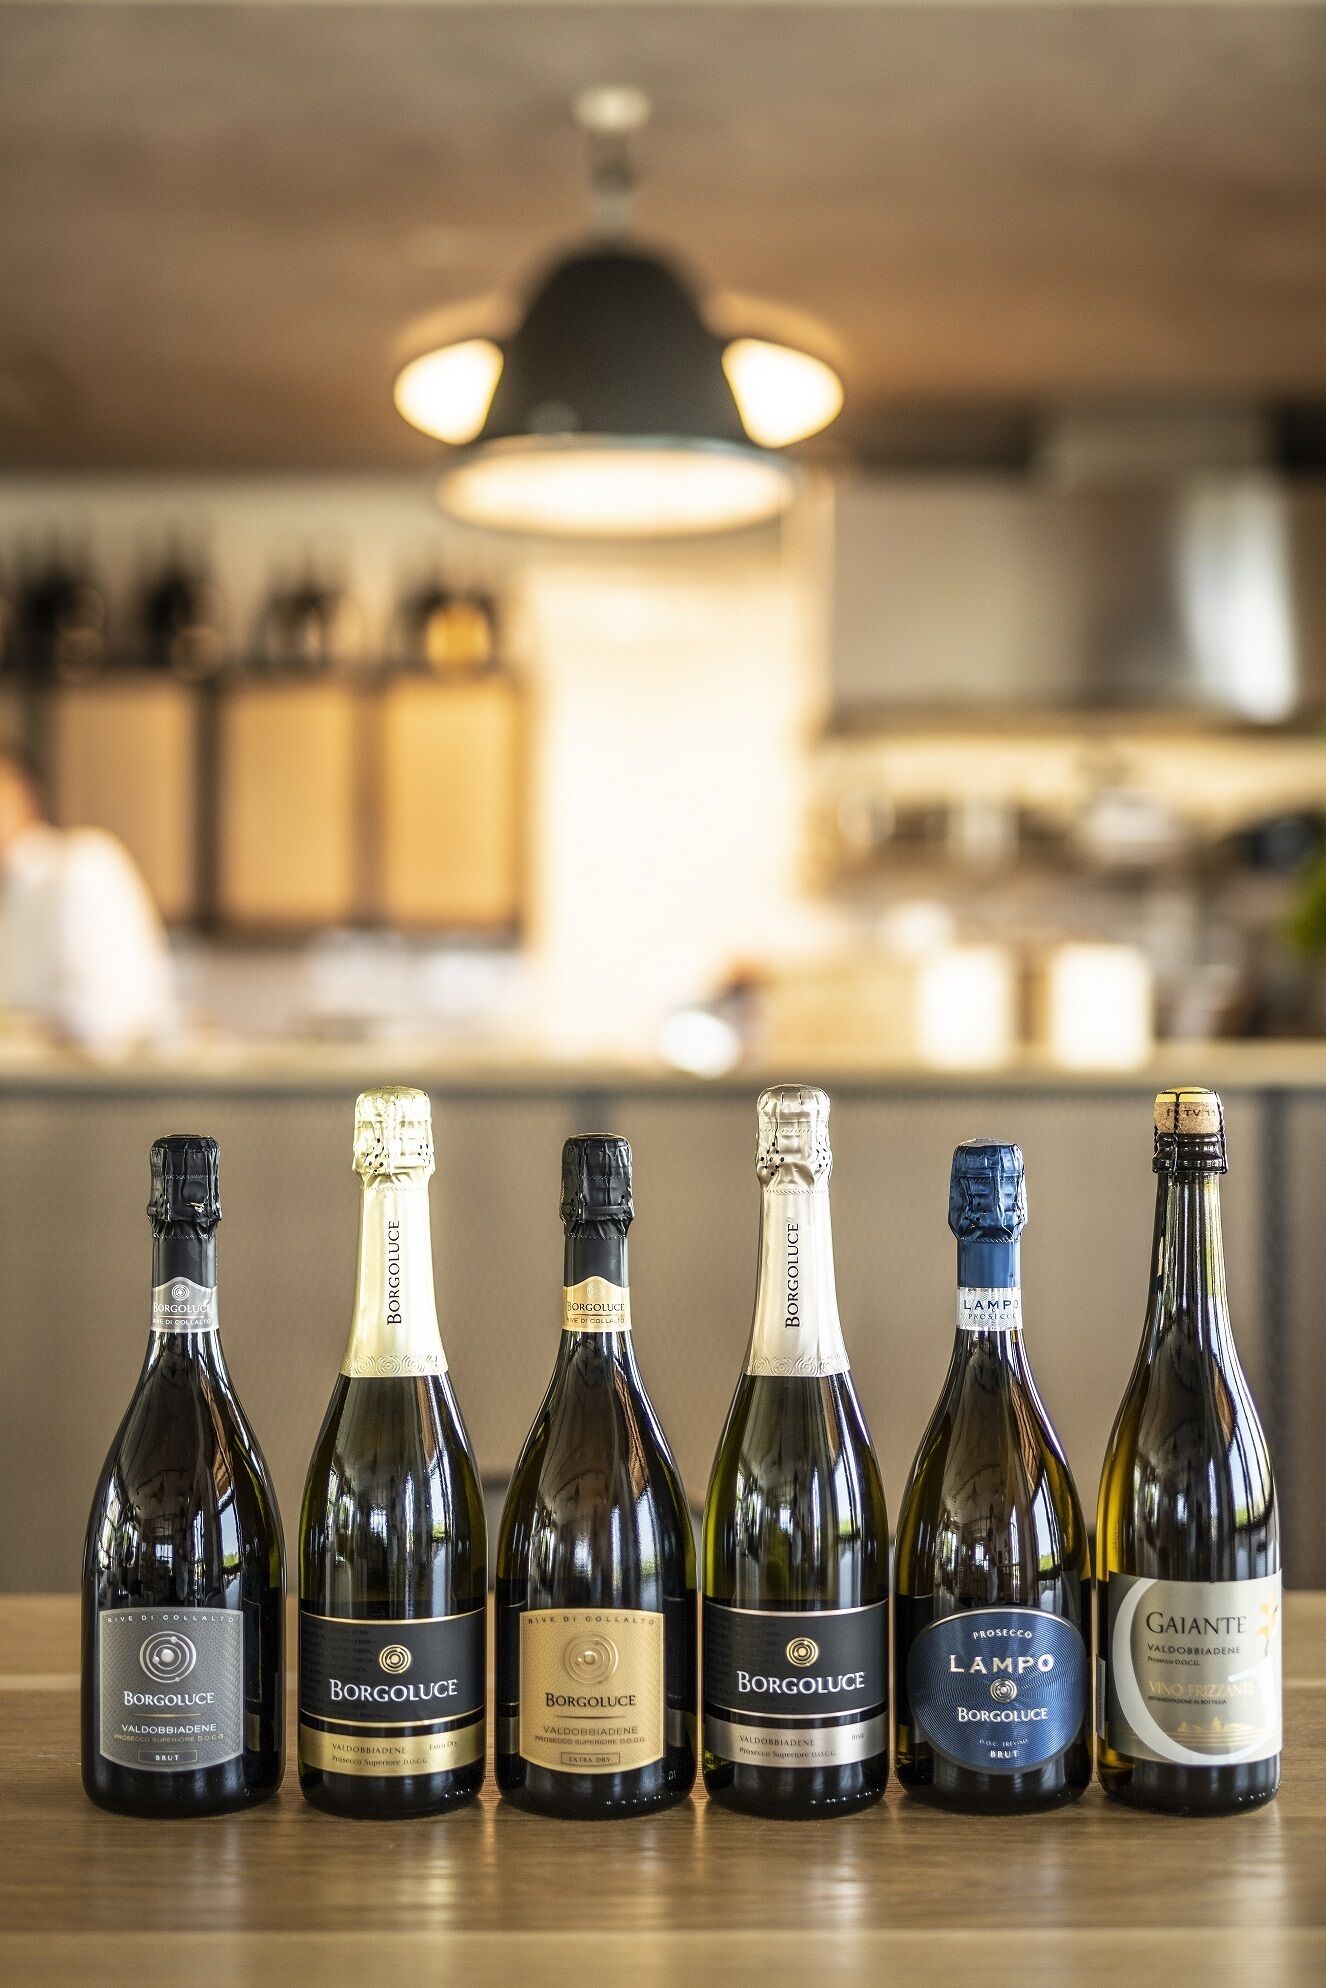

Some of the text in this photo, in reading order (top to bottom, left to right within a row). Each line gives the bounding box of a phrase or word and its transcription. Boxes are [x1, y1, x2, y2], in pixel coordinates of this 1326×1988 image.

[387, 1220, 402, 1325] BORGOLUCE
[785, 1223, 800, 1328] BORGOLUCE
[153, 1302, 211, 1313] BORGOLUCE
[108, 1615, 133, 1623] RIVE
[163, 1614, 234, 1623] COLLALTO
[528, 1616, 555, 1624] RIVE
[586, 1616, 655, 1625] COLLALTO
[1145, 1611, 1248, 1635] GAIANTE
[972, 1629, 1033, 1640] PROSECCO
[1146, 1643, 1240, 1656] VALDOBBIADENE
[949, 1653, 1055, 1675] LAMPO
[736, 1670, 866, 1694] BORGOLUCE
[1148, 1680, 1184, 1696] VINO
[329, 1678, 459, 1702] BORGOLUCE
[123, 1691, 215, 1706] BORGOLUCE
[545, 1692, 636, 1708] BORGOLUCE
[957, 1706, 1049, 1723] BORGOLUCE
[121, 1724, 217, 1734] VALDOBBIADENE
[543, 1726, 639, 1736] VALDOBBIADENE
[739, 1734, 815, 1746] VALDOBBIADENE
[332, 1743, 406, 1755] VALDOBBIADENE
[739, 1747, 771, 1757] Prosecco
[773, 1750, 808, 1759] Superiore
[990, 1750, 1018, 1759] BRUT
[332, 1755, 362, 1765] Prosecco
[364, 1758, 401, 1768] Superiore
